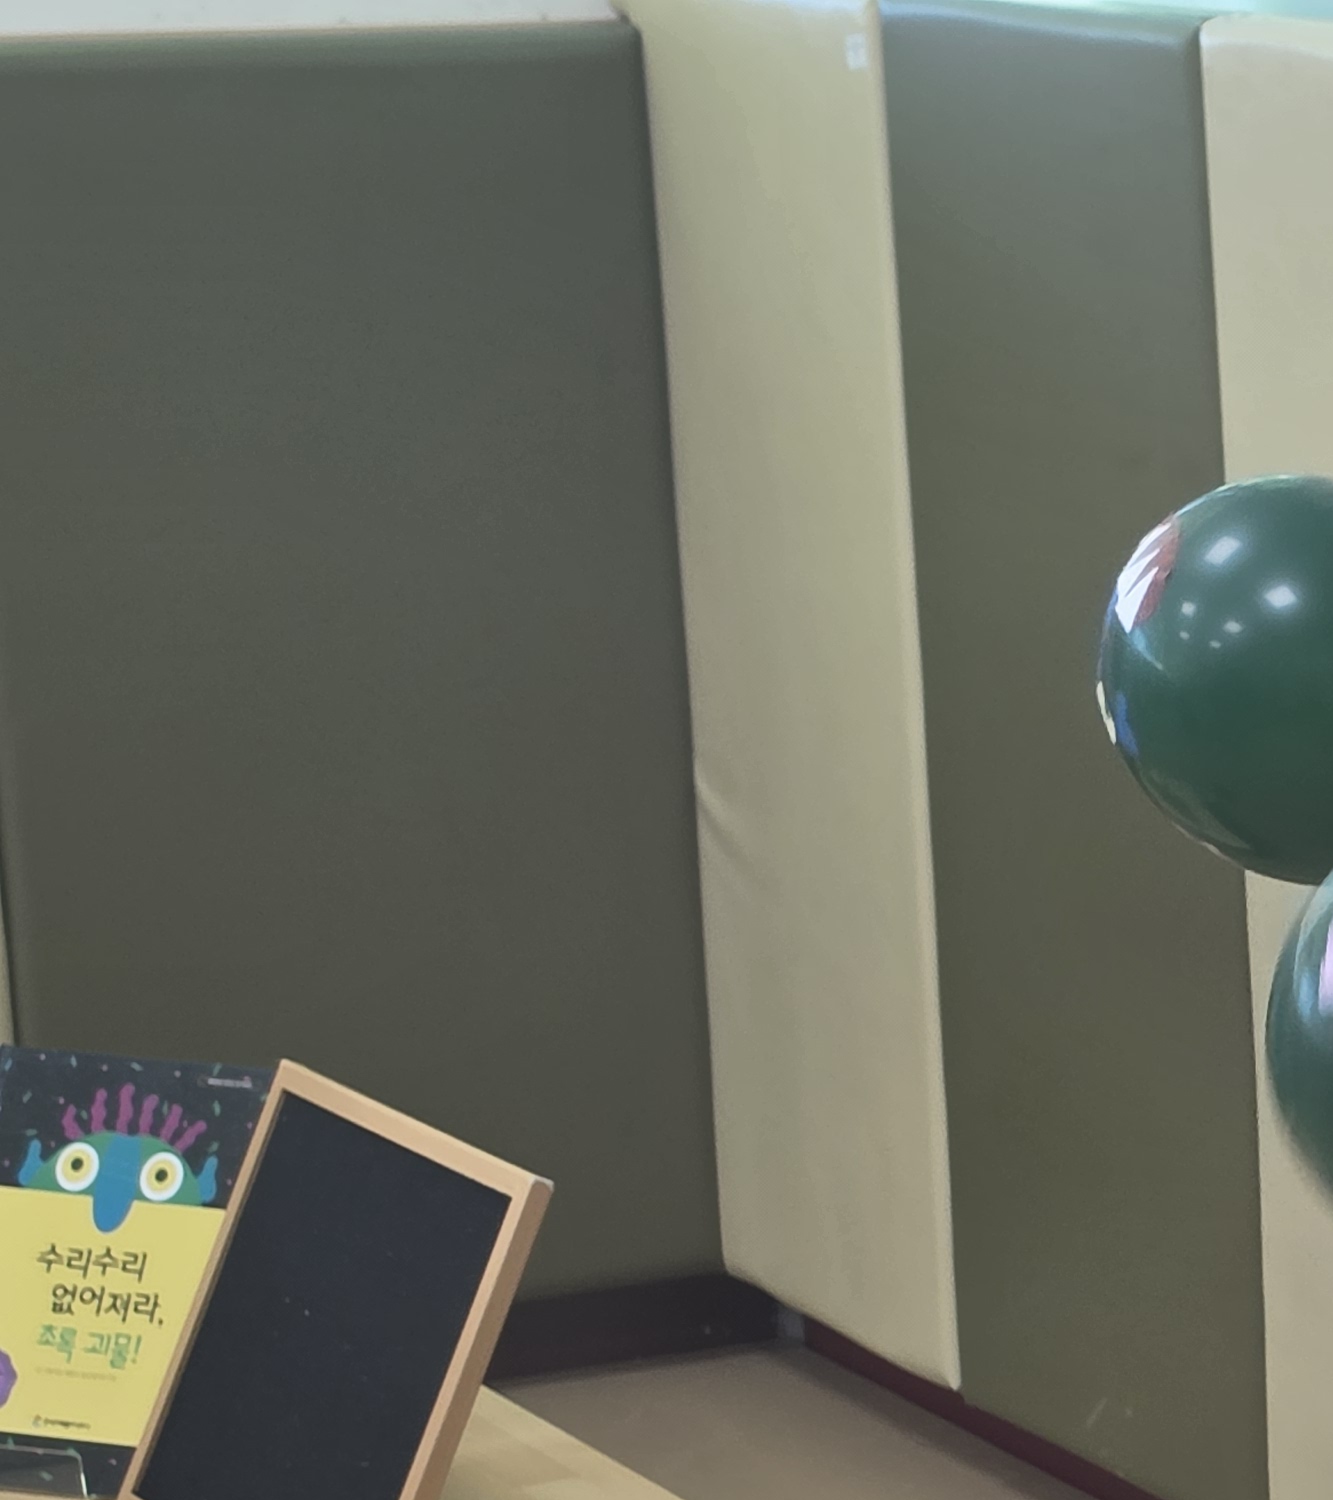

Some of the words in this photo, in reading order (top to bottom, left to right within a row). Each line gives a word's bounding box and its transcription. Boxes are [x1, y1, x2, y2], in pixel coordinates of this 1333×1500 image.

[36, 1243, 147, 1284] 수리수리
[37, 1323, 77, 1364] 초록
[82, 1332, 142, 1370] 괴물!
